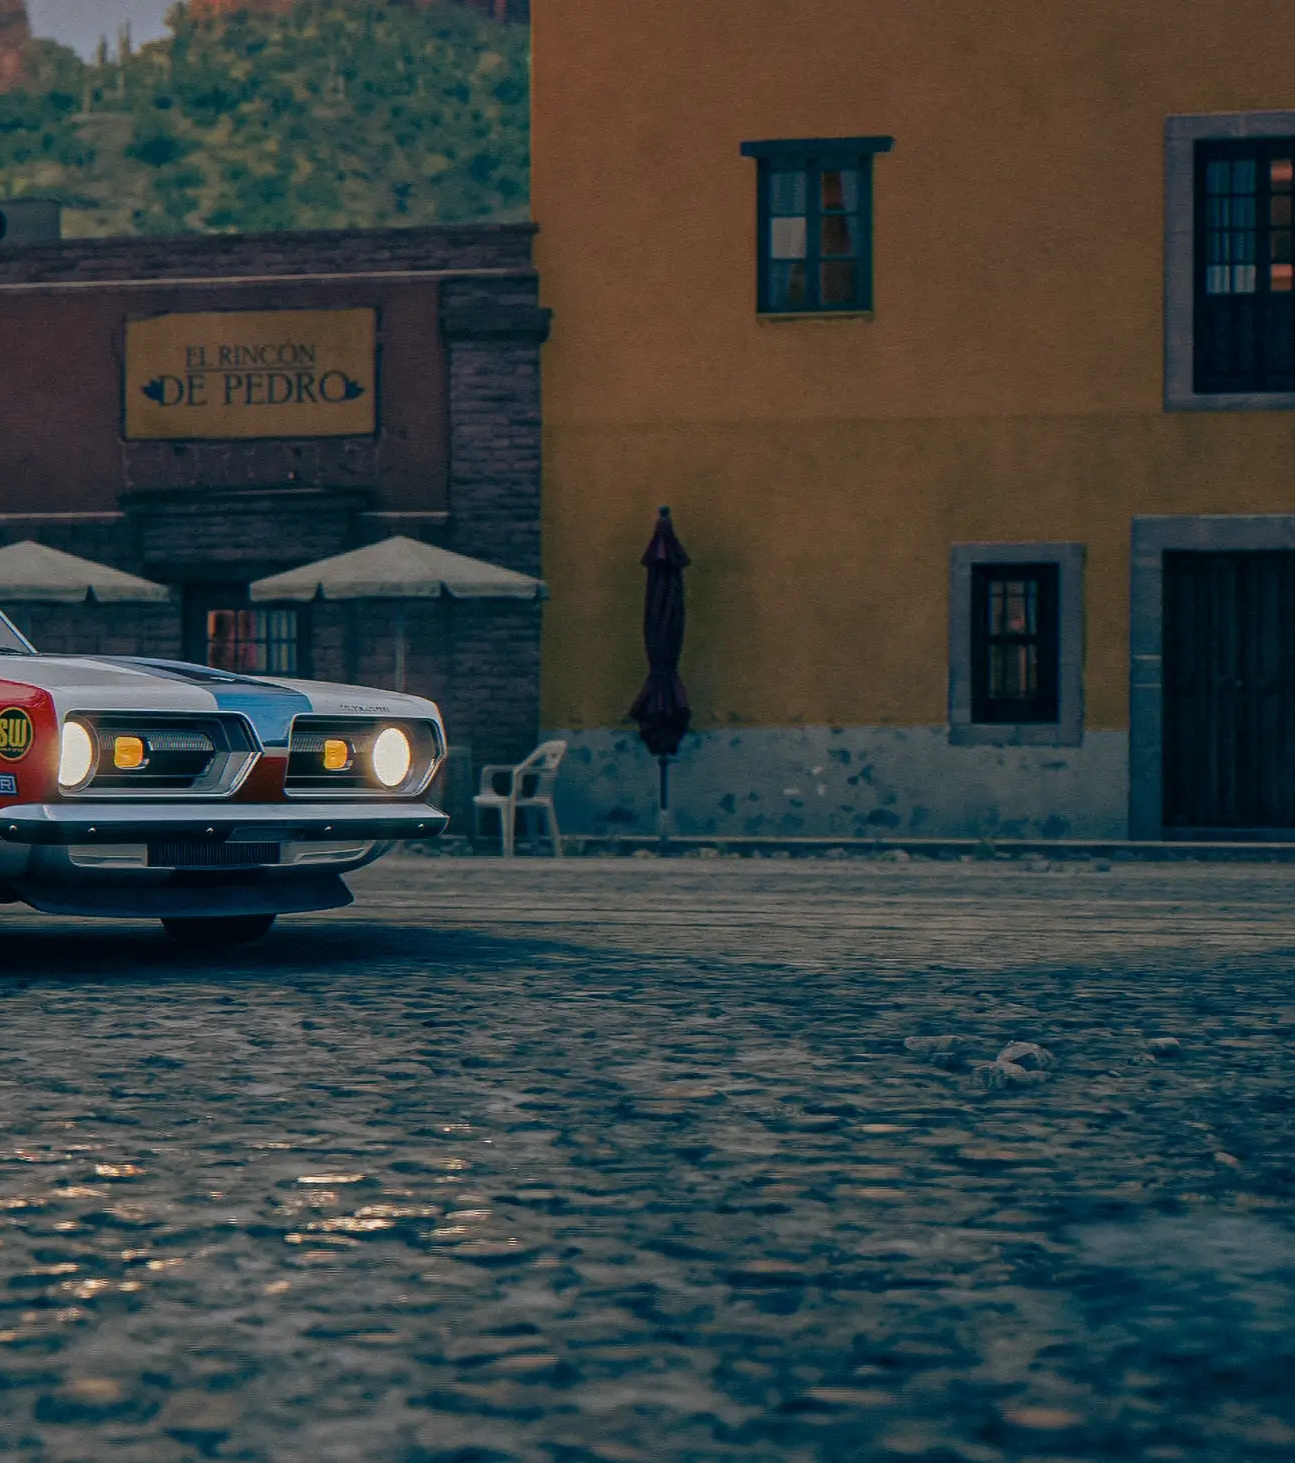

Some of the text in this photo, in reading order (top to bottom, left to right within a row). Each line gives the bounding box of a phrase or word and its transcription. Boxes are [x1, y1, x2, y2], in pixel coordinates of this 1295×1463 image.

[186, 339, 317, 368] EL RINCÓN
[159, 369, 352, 407] DE PEDRO
